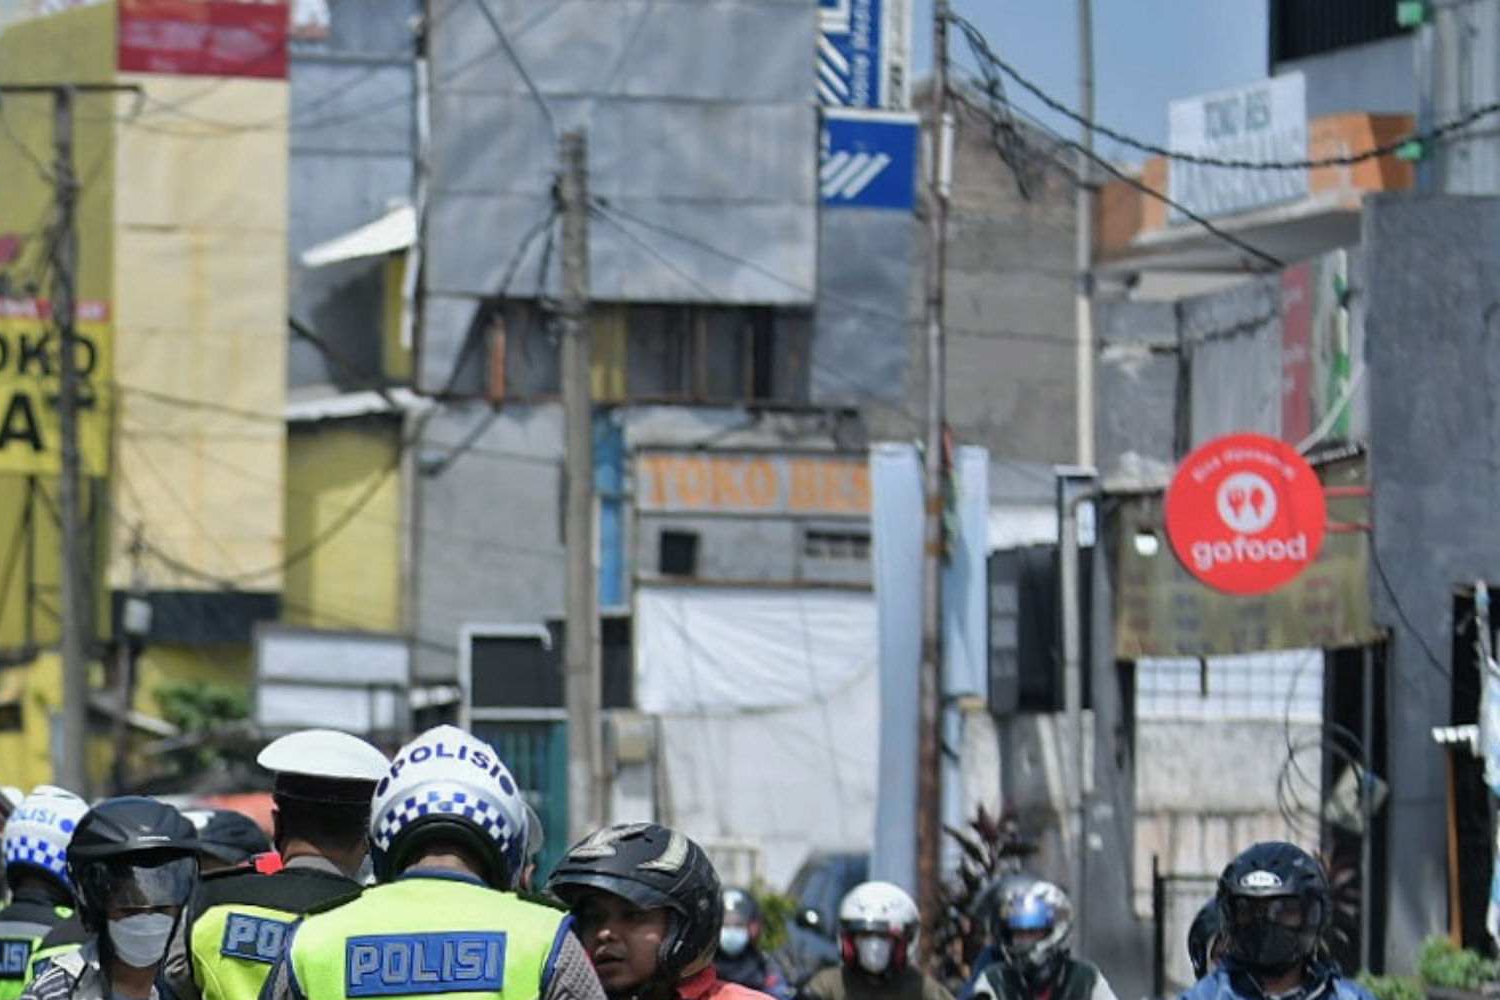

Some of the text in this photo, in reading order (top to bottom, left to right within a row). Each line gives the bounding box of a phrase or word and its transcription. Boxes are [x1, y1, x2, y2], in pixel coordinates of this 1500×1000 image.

[642, 454, 778, 506] TOKO
[1190, 533, 1308, 572] gofood
[389, 742, 501, 778] POLISI
[350, 940, 499, 985] POLISI
